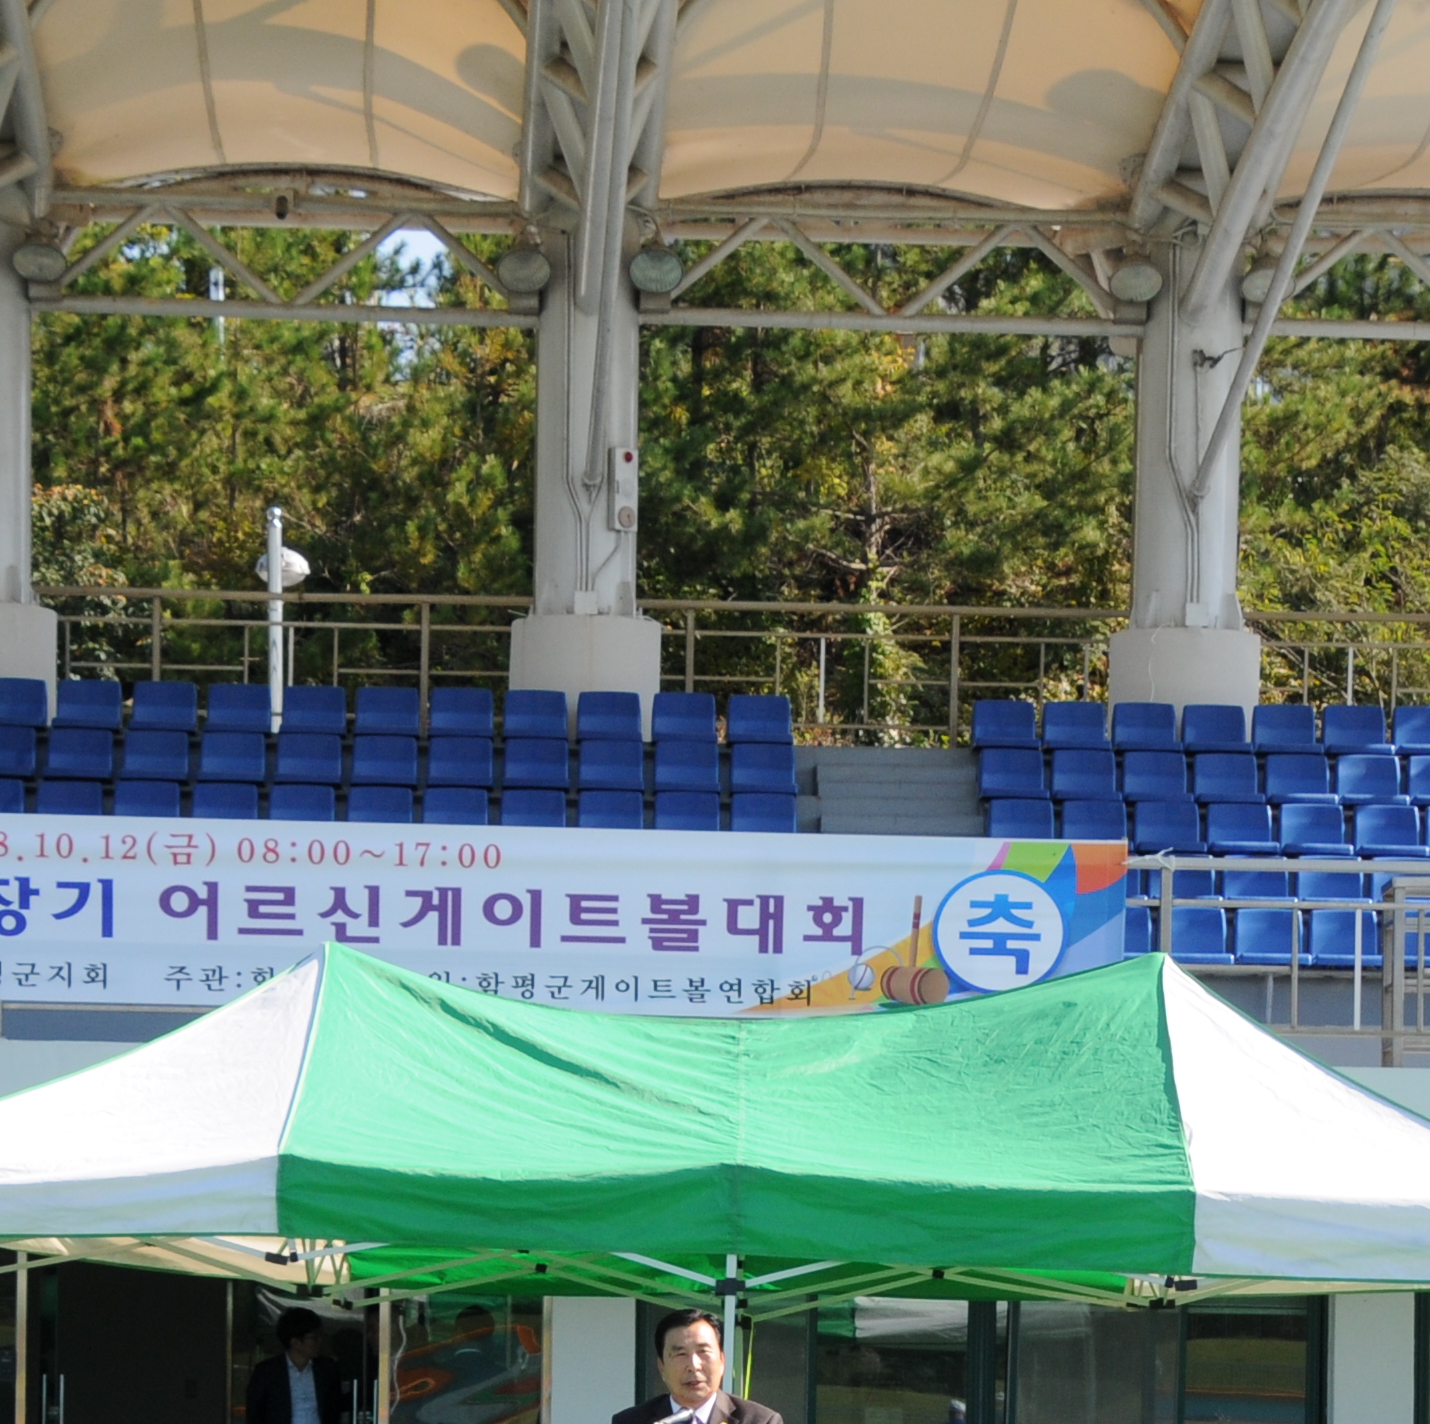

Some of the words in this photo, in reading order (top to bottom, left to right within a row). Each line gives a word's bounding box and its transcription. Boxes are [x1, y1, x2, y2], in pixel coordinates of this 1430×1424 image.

[236, 837, 503, 870] 08:00~17:00
[157, 880, 866, 957] 어르신게이트볼대회
[958, 893, 1043, 976] 축
